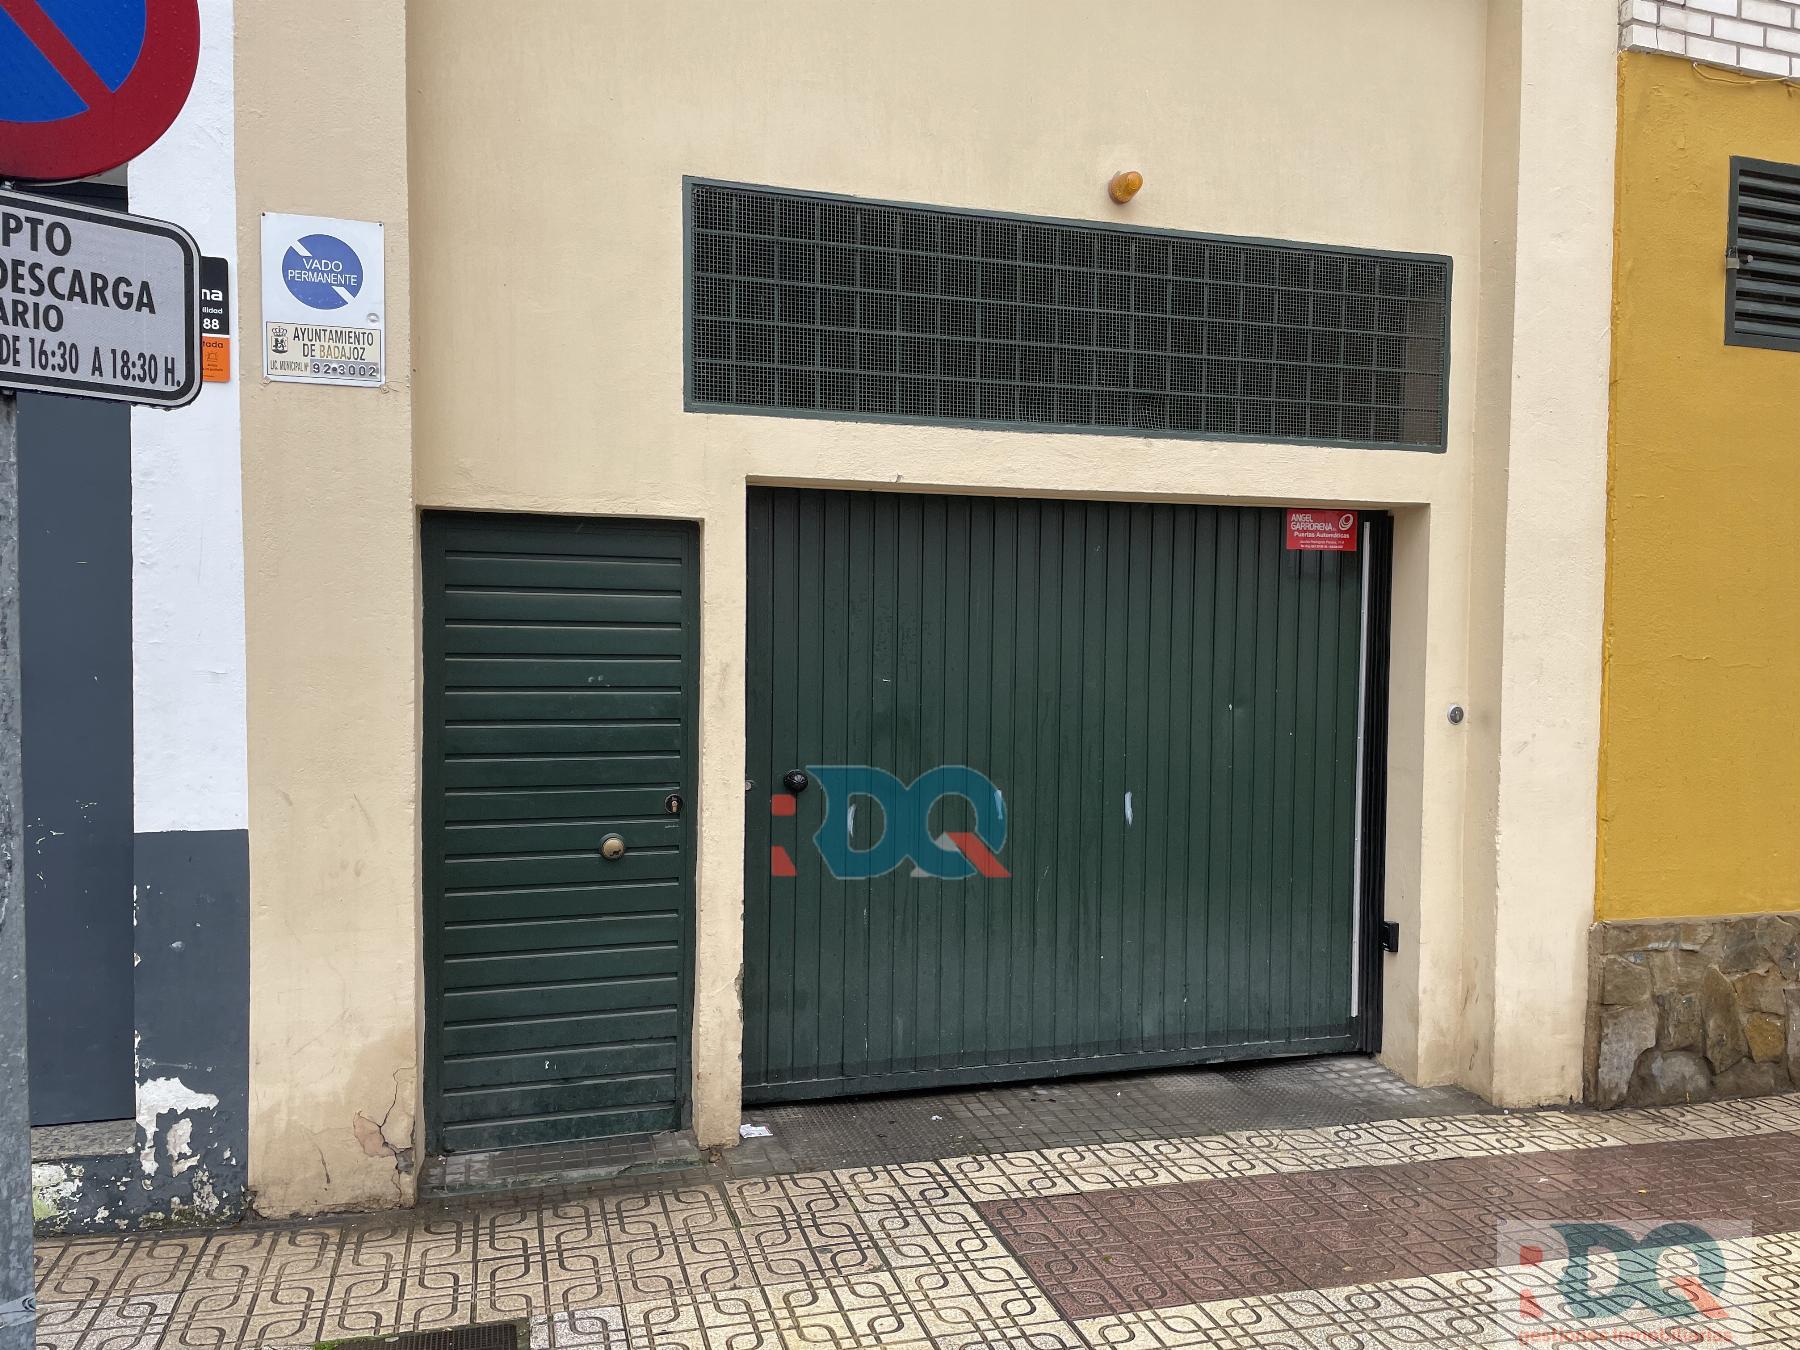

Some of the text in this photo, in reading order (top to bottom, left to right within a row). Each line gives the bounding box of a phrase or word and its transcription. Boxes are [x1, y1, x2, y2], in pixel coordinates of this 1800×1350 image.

[1, 212, 72, 256] PTO
[302, 258, 343, 272] VADO
[288, 270, 358, 286] PERMANENTE
[202, 317, 220, 330] 88
[293, 326, 374, 347] AYUNTAMIENTO
[0, 333, 181, 388] DE 16:30 A 18:30 H.
[302, 343, 366, 361] DE BADAJOZ
[1290, 513, 1313, 522] ANGEL
